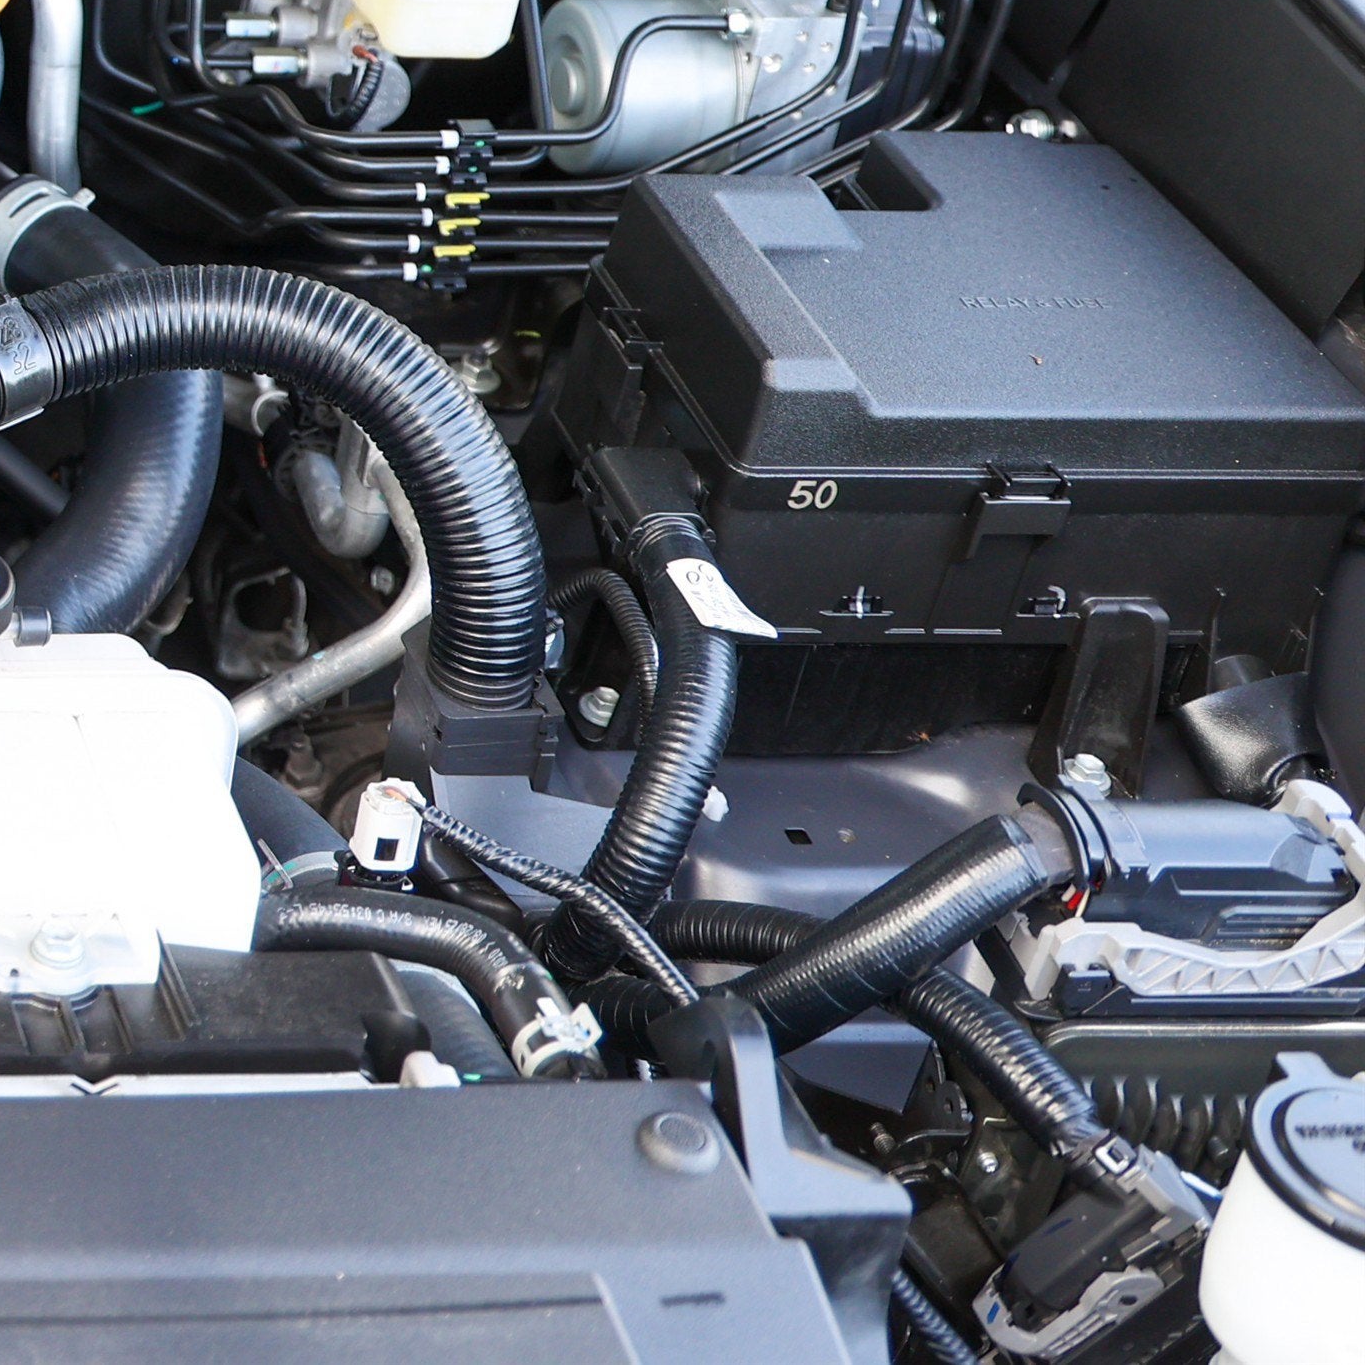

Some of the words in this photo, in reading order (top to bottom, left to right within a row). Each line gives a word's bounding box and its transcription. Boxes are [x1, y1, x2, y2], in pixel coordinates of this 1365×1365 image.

[959, 296, 1032, 309] RELAY
[1035, 298, 1051, 309] &
[1053, 296, 1112, 309] FUSE
[787, 479, 838, 510] 50
